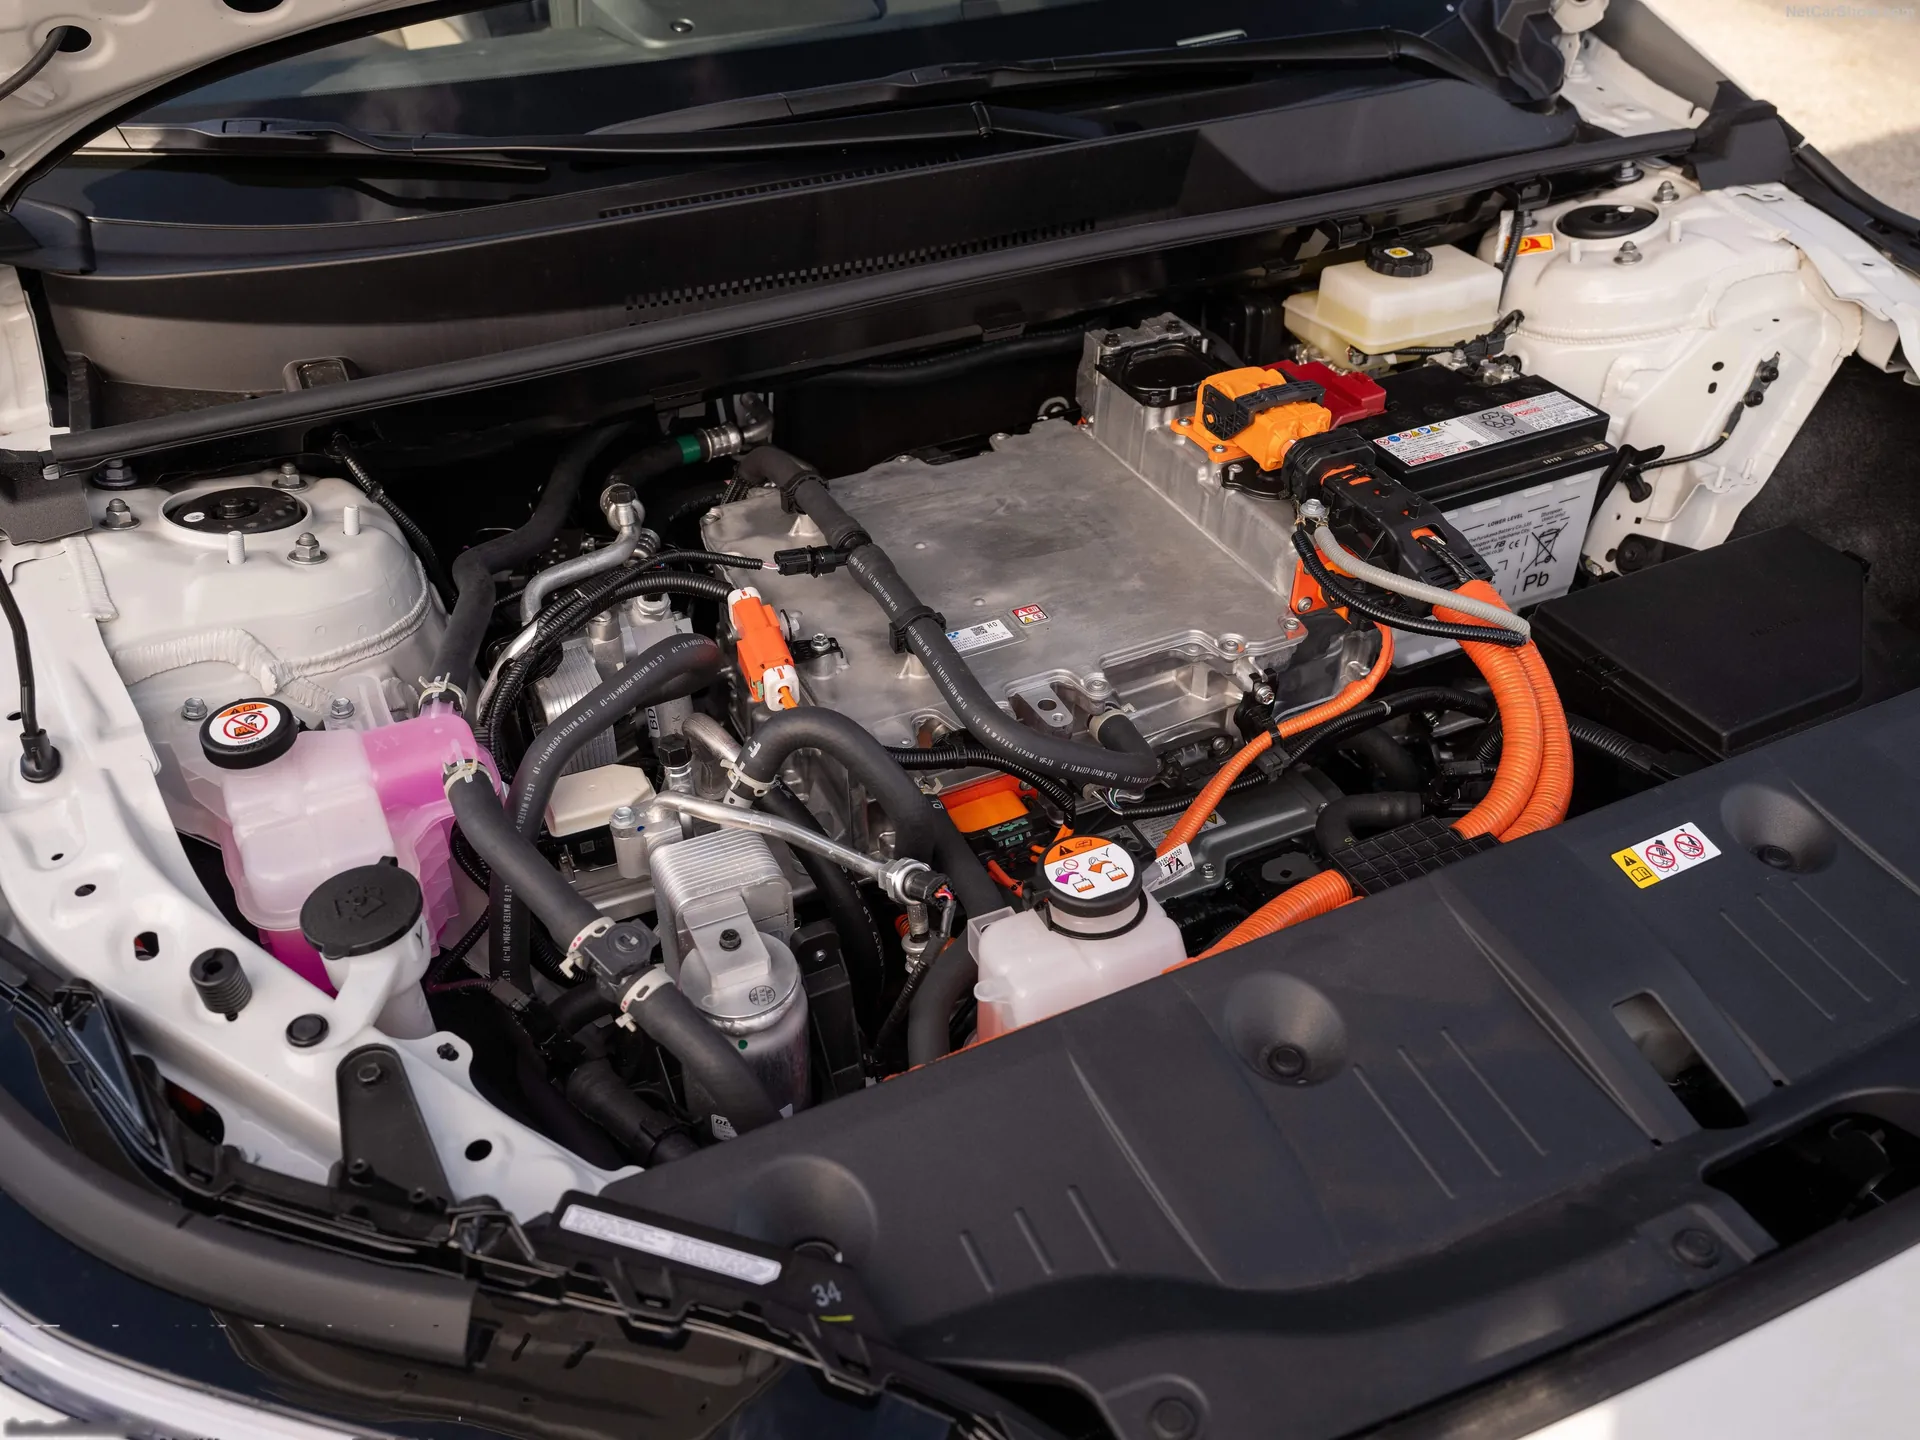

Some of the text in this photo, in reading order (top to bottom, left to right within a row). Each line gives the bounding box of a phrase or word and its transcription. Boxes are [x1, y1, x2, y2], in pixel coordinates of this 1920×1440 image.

[1488, 514, 1523, 527] LOWER LEVEL
[1523, 571, 1549, 592] Pb
[632, 665, 650, 682] WATER
[559, 719, 579, 738] WATER
[648, 708, 658, 730] BD
[991, 729, 1013, 750] WATER
[515, 801, 529, 824] WATER
[1164, 858, 1184, 874] TA
[811, 1280, 842, 1307] 34
